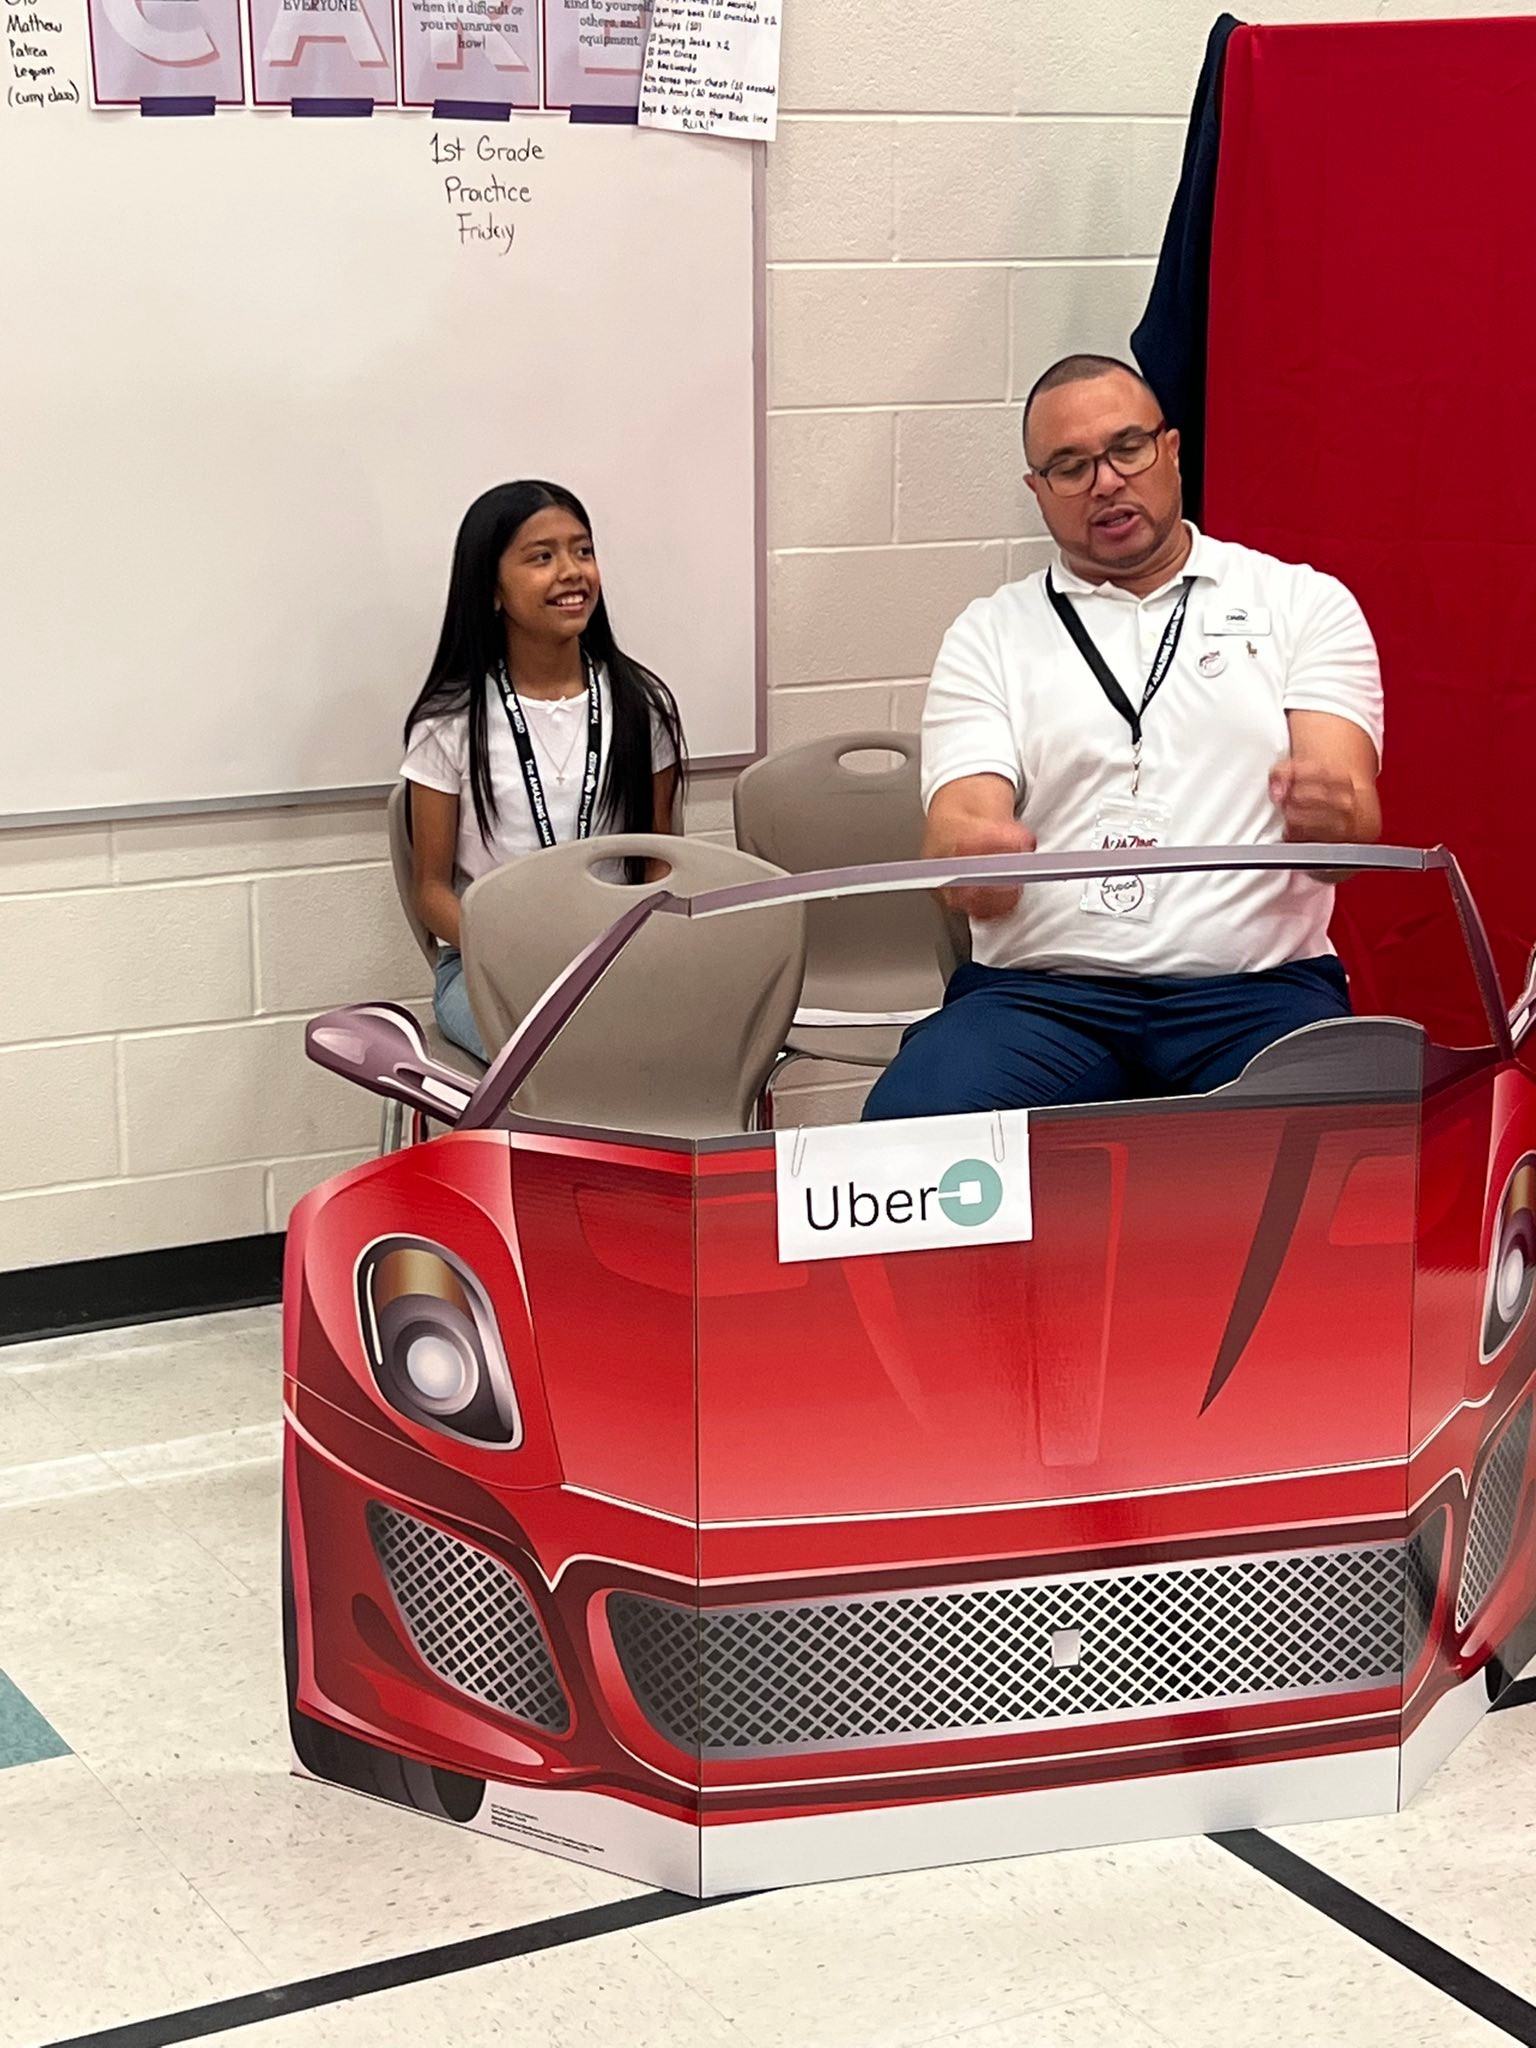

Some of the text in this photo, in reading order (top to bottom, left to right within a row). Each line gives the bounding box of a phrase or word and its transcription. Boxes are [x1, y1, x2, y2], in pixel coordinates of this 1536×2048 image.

[412, 0, 445, 13] when
[466, 0, 509, 15] difficult
[511, 7, 524, 16] or
[564, 0, 589, 9] kind
[592, 0, 602, 10] to
[459, 20, 502, 32] unsure
[504, 23, 519, 33] on
[620, 16, 641, 29] and
[429, 132, 546, 164] 1st Grade
[445, 173, 532, 204] Practice
[456, 211, 515, 256] Friday
[529, 776, 546, 820] AMAZING
[806, 1181, 938, 1231] Uber
